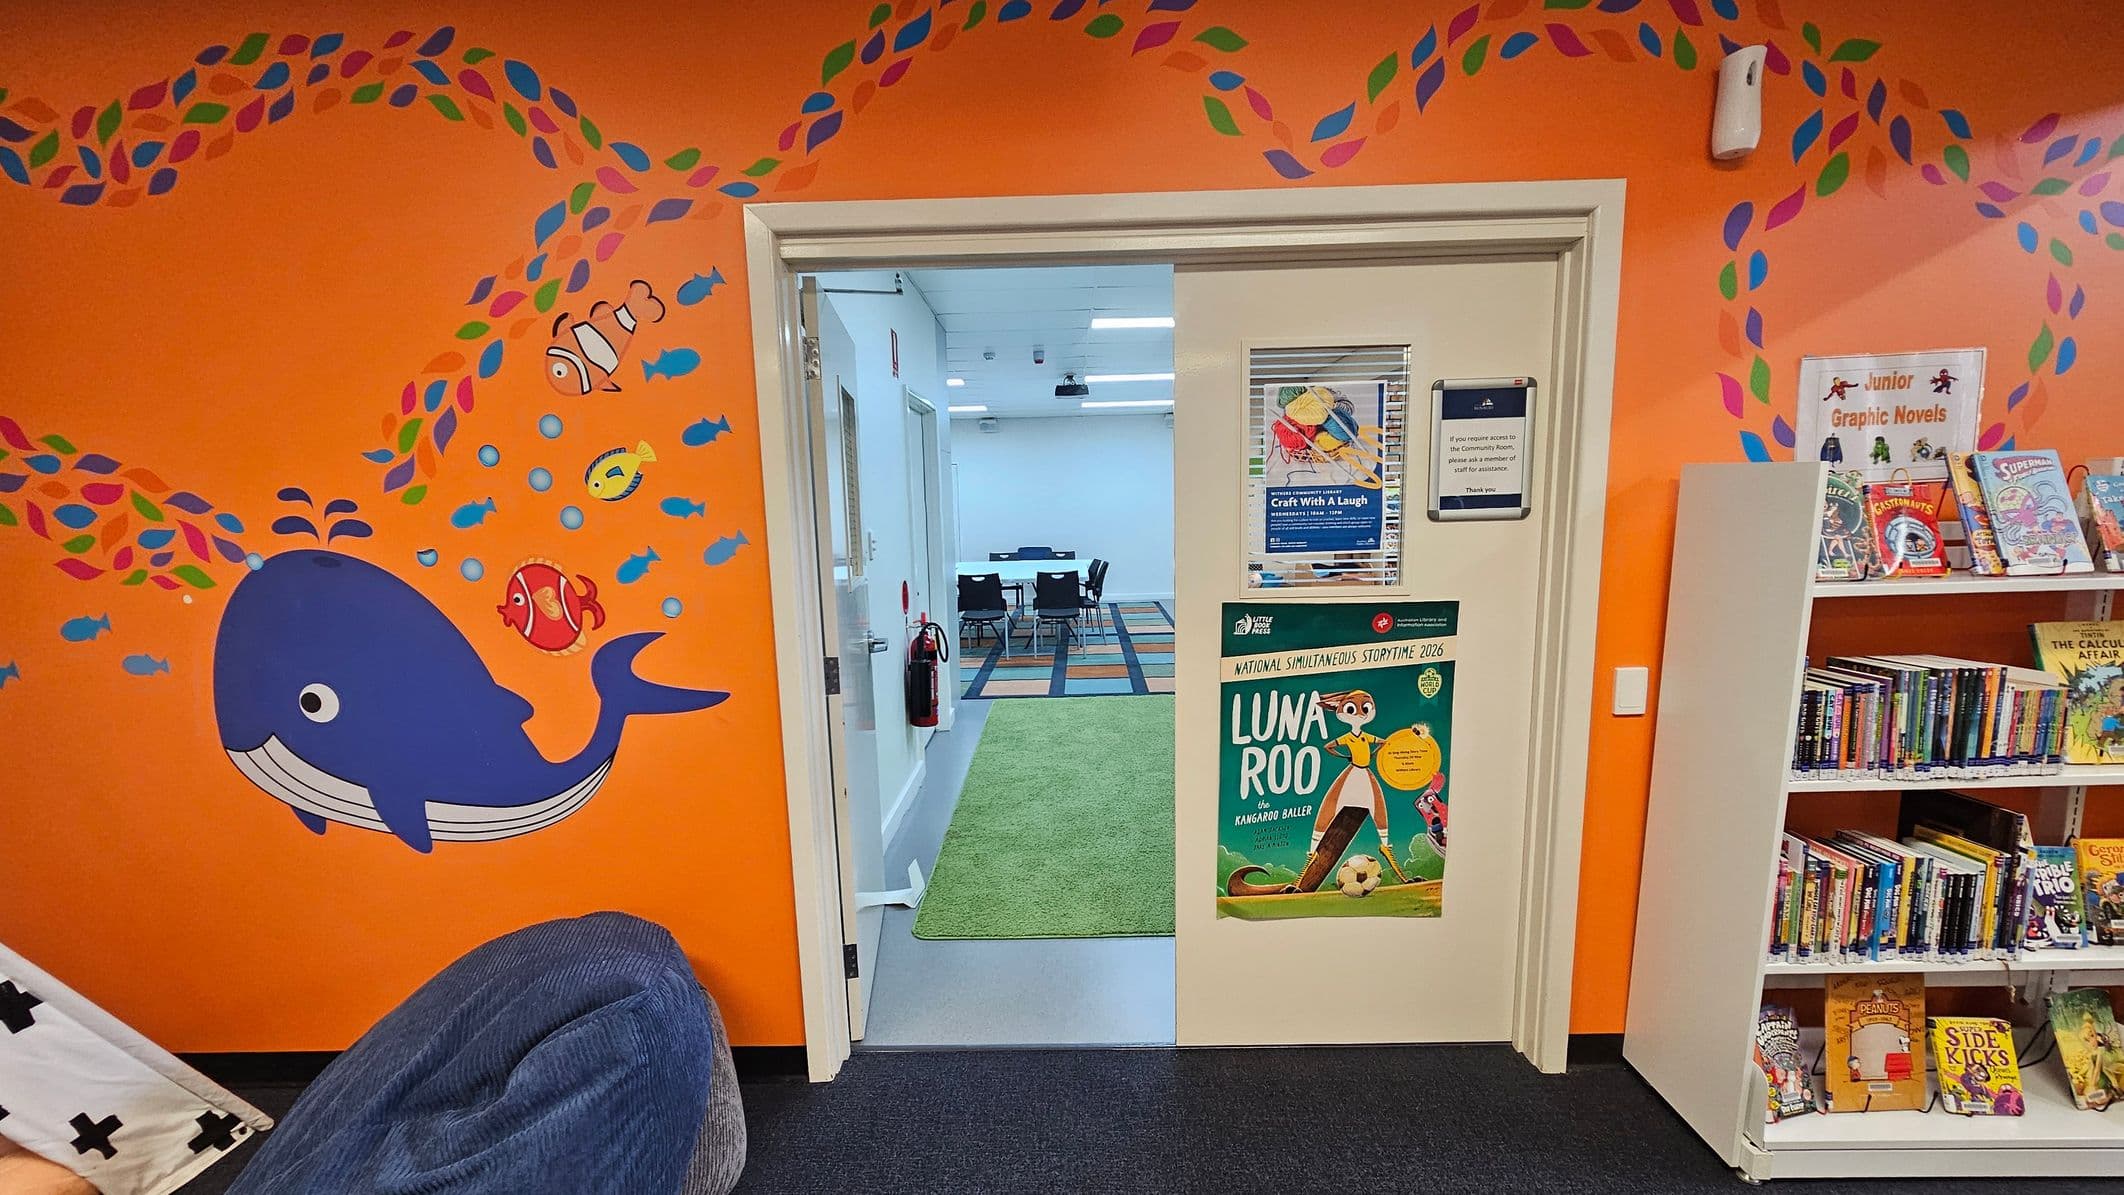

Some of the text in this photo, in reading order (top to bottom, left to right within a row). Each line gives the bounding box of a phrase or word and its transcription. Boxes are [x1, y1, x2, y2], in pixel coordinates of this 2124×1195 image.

[1864, 371, 1914, 391] Junior
[1832, 404, 1947, 430] Graphic Novels
[1271, 495, 1368, 508] Craft With A Laugh
[1874, 498, 1934, 516] GASTRONAUTS
[2052, 641, 2076, 649] THE
[2079, 650, 2120, 660] AFFAIR
[1235, 643, 1444, 676] NATIONAL SIMULTANEOUS STORYTIME 2026
[1232, 690, 1328, 745] LUNA
[1241, 744, 1321, 800] ROO
[1258, 800, 1270, 809] the
[1235, 805, 1312, 826] KANGAROO BALLER
[2033, 877, 2075, 896] TRIO
[1860, 1003, 1899, 1014] PEANUTS
[1946, 1027, 2000, 1048] SIDE
[1945, 1047, 2010, 1068] KICKS
